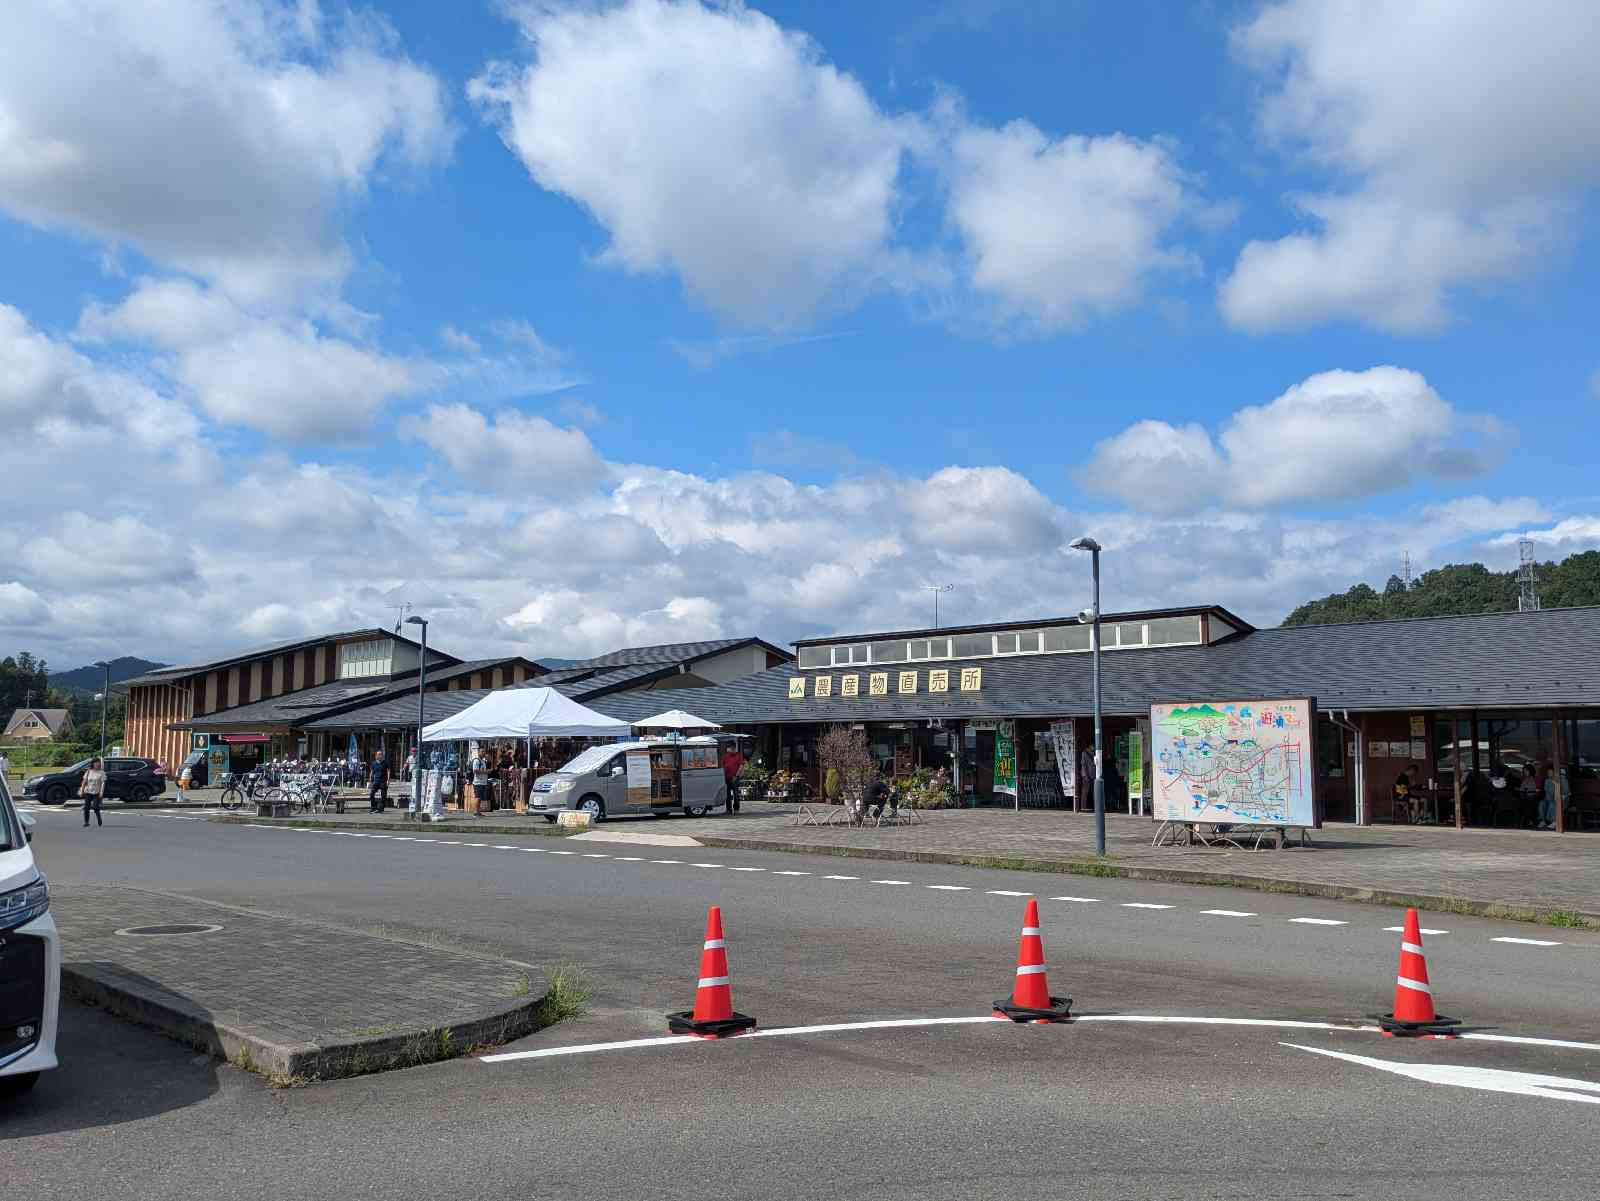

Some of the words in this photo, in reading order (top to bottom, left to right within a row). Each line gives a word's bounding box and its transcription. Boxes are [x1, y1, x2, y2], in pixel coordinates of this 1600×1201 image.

[817, 669, 980, 696] 農産物直売所
